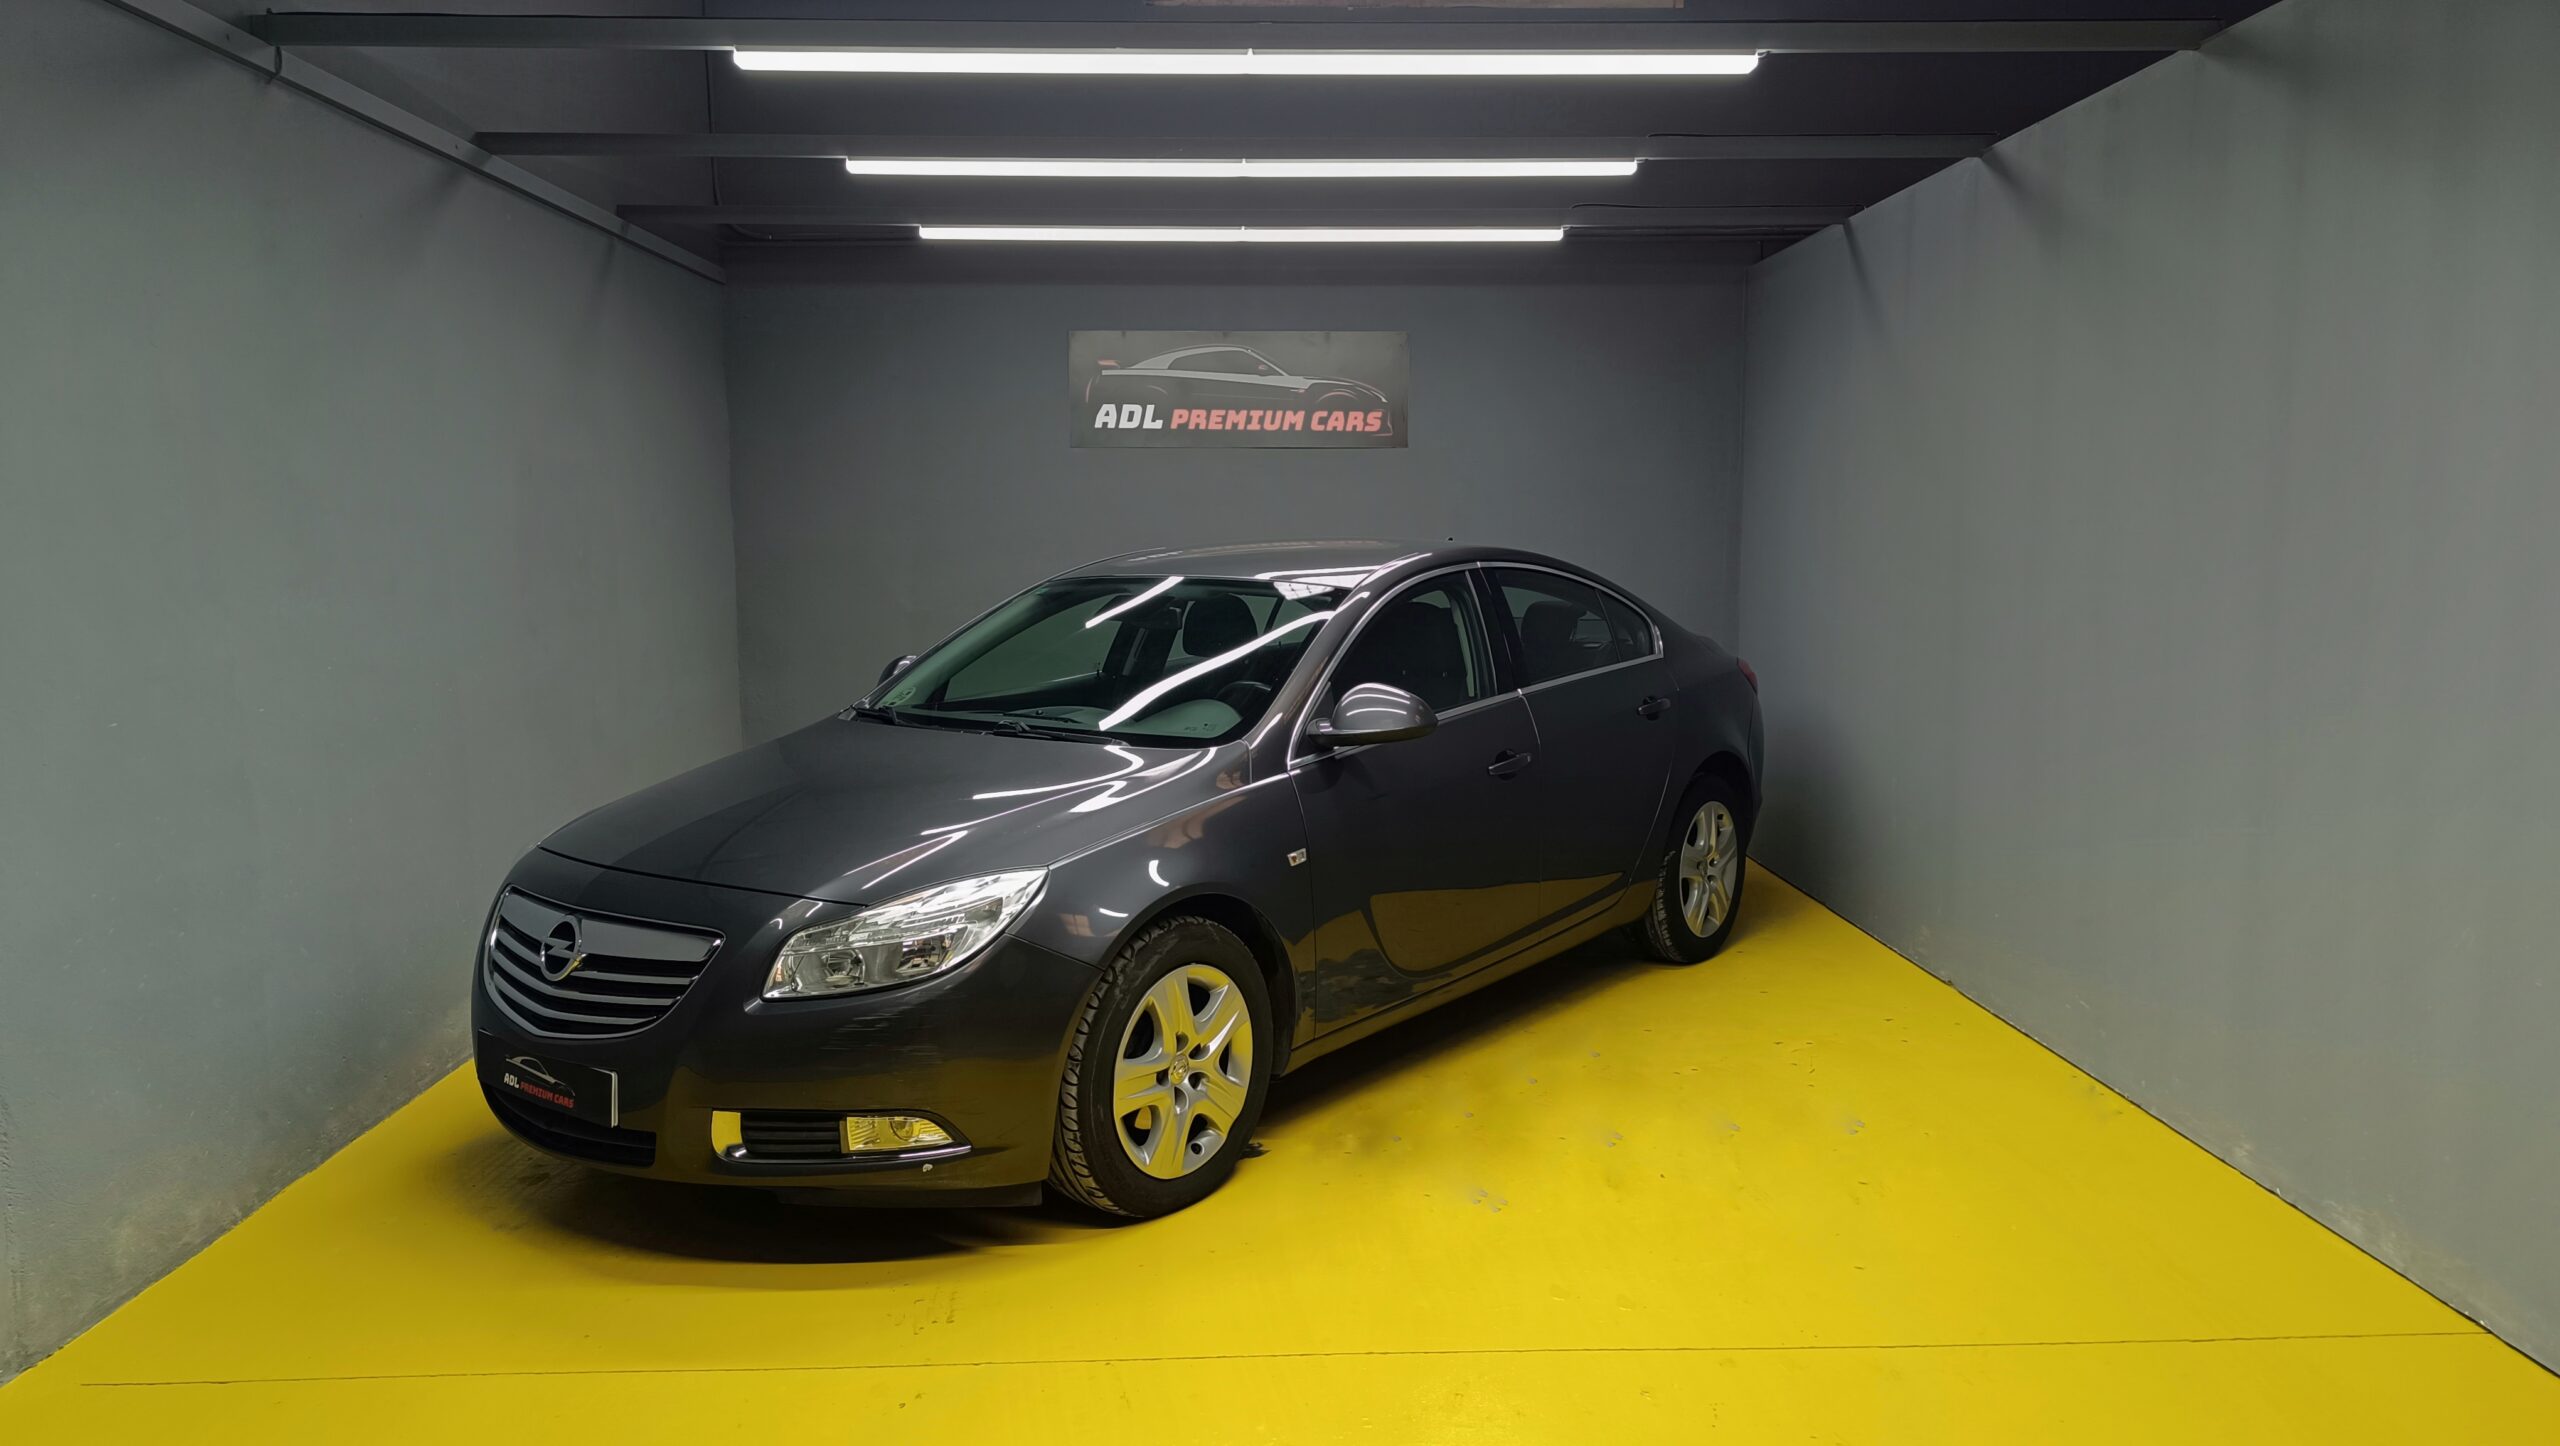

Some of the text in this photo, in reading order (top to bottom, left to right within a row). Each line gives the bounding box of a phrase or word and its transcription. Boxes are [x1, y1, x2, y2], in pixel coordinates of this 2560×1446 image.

[1094, 404, 1383, 433] ADL PREMIUM CARS
[503, 1072, 575, 1109] ADL PREMIUM CARS
